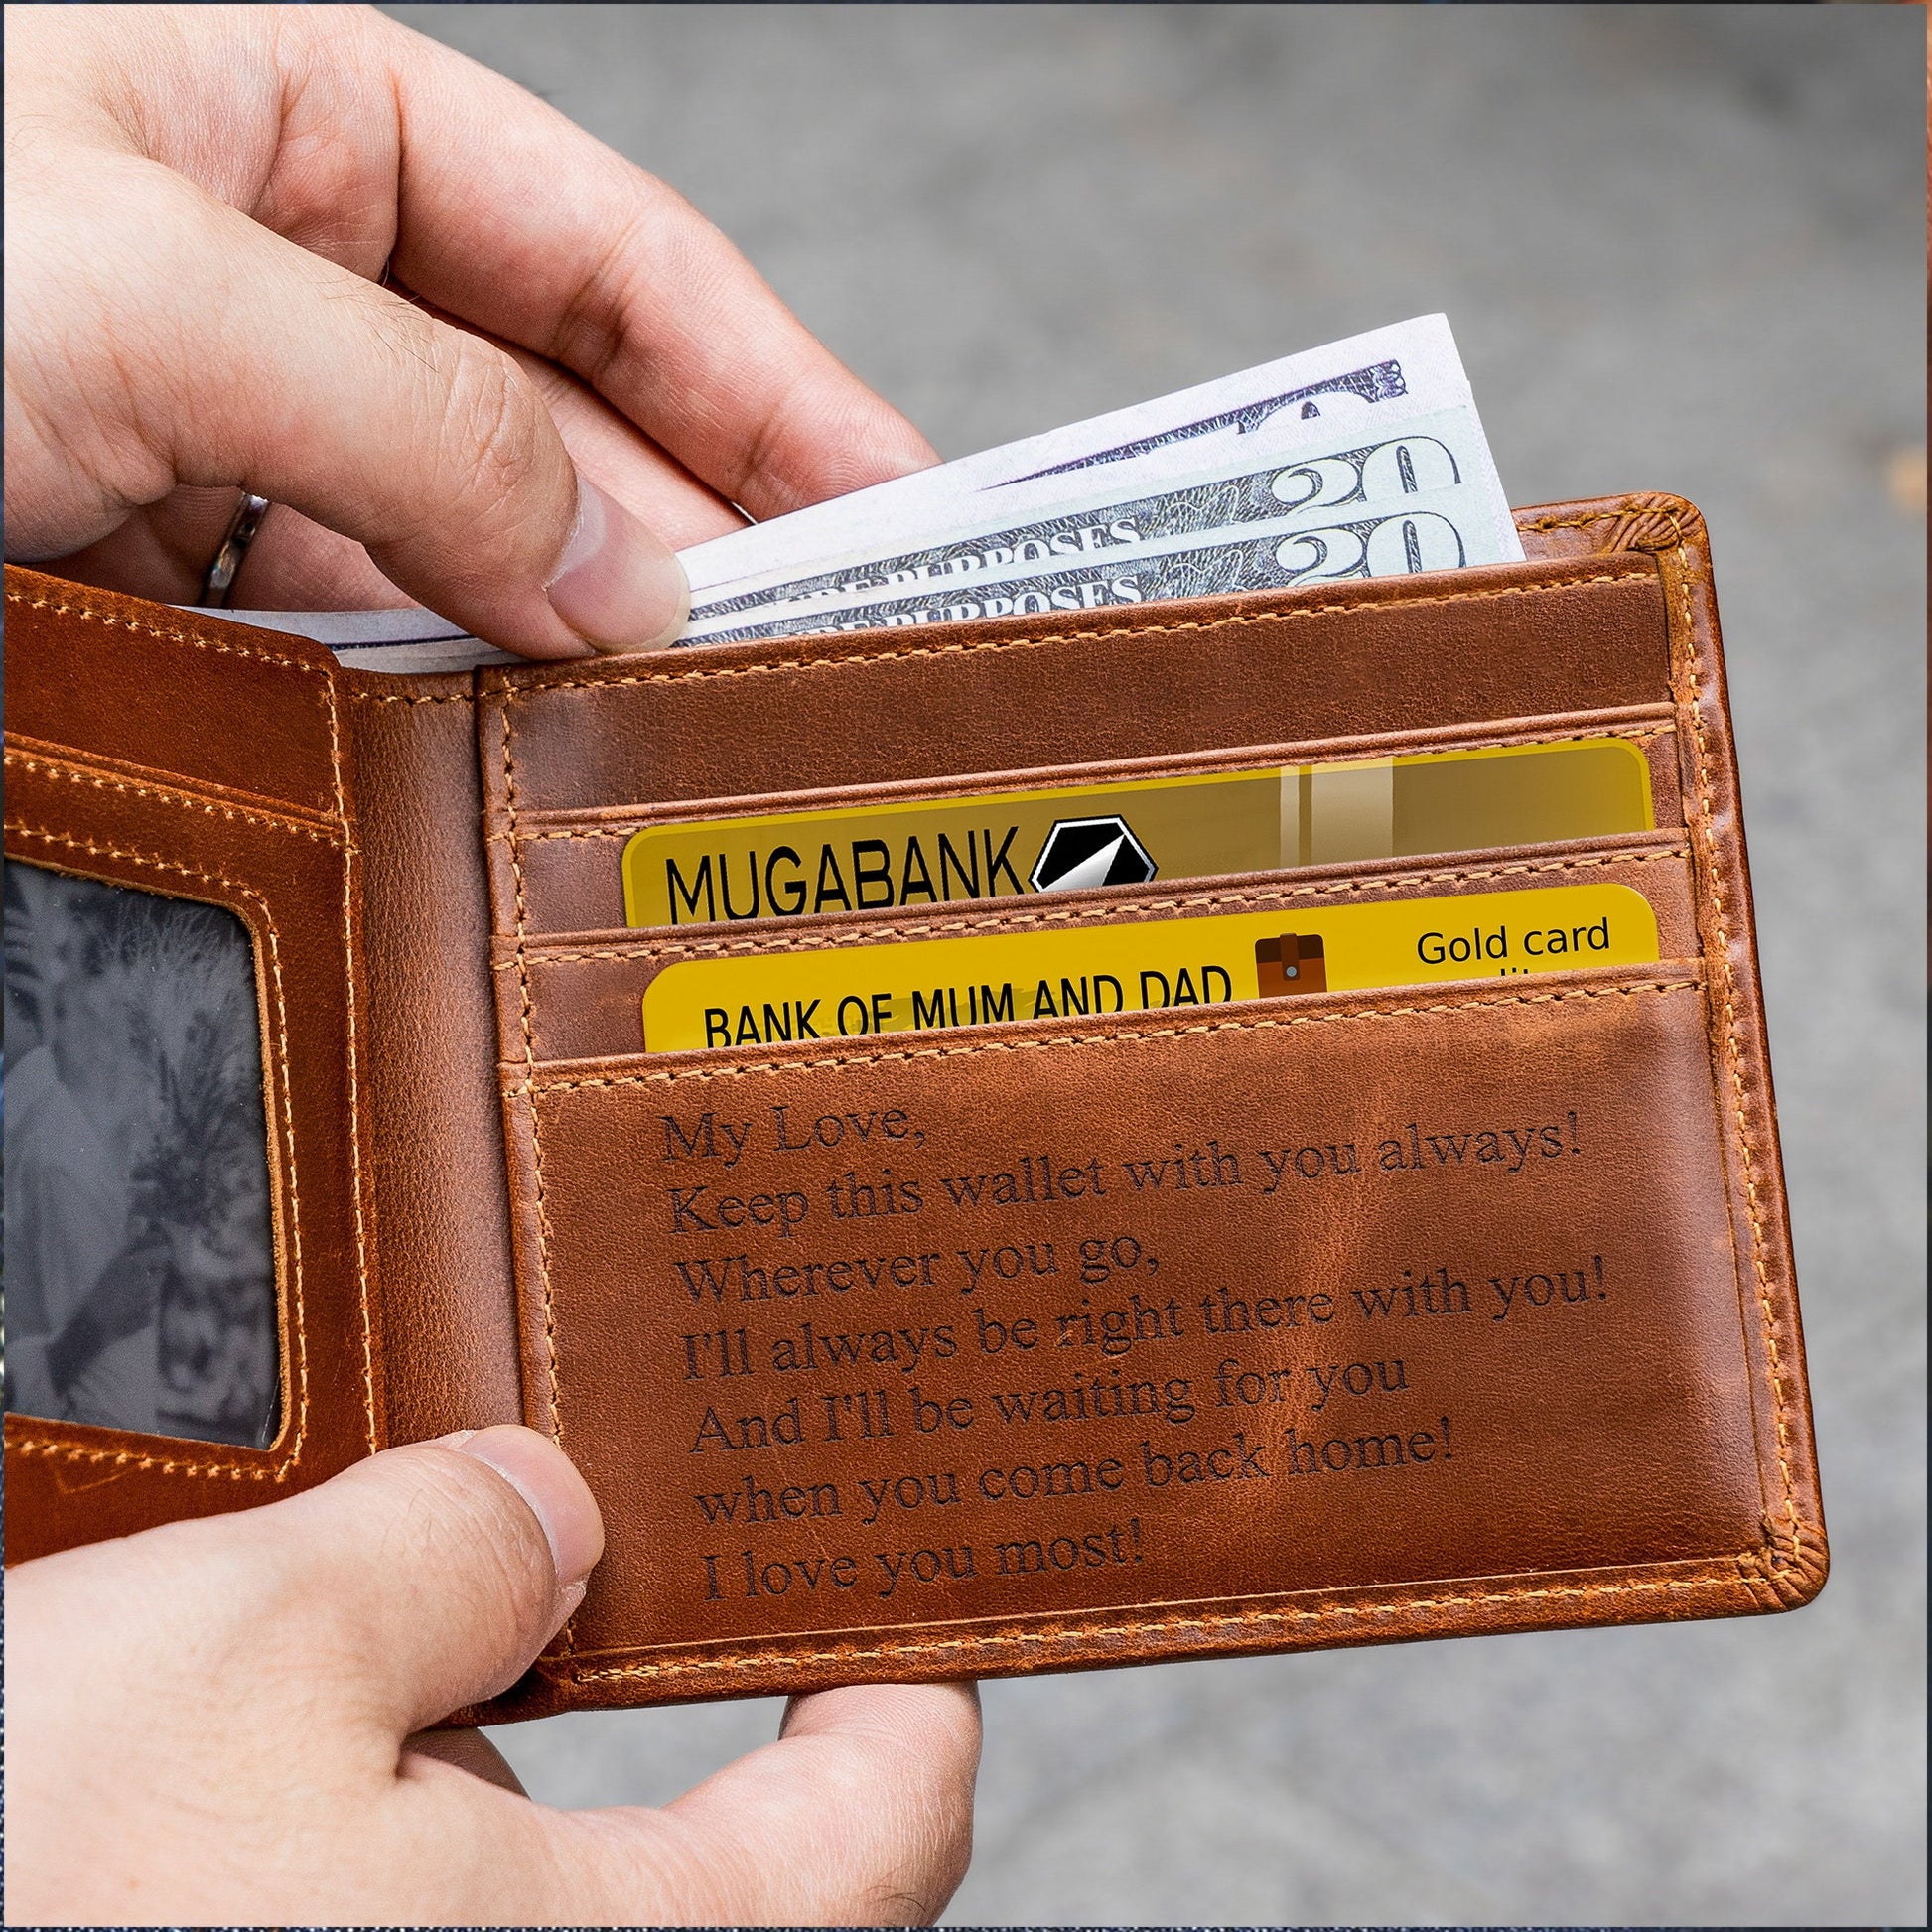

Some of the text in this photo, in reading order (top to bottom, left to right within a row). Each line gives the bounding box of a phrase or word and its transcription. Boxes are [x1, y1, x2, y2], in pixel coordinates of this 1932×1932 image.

[1271, 436, 1462, 516] 20
[1275, 510, 1467, 586] 20
[665, 825, 1024, 925] MUGABANK
[1417, 916, 1610, 965] Gold card
[704, 965, 1232, 1048] BANK OF MUM AND DAD
[659, 1105, 925, 1168] My Love,
[666, 1111, 1582, 1238] Keep this wallet with you always!
[672, 1236, 1160, 1304] Wherever you go,
[680, 1254, 1607, 1381] I'll always be right there with you!
[688, 1357, 1411, 1453] And I'll be waiting for you
[694, 1416, 1455, 1525] when you come back home!
[701, 1518, 1144, 1601] I love you most!
